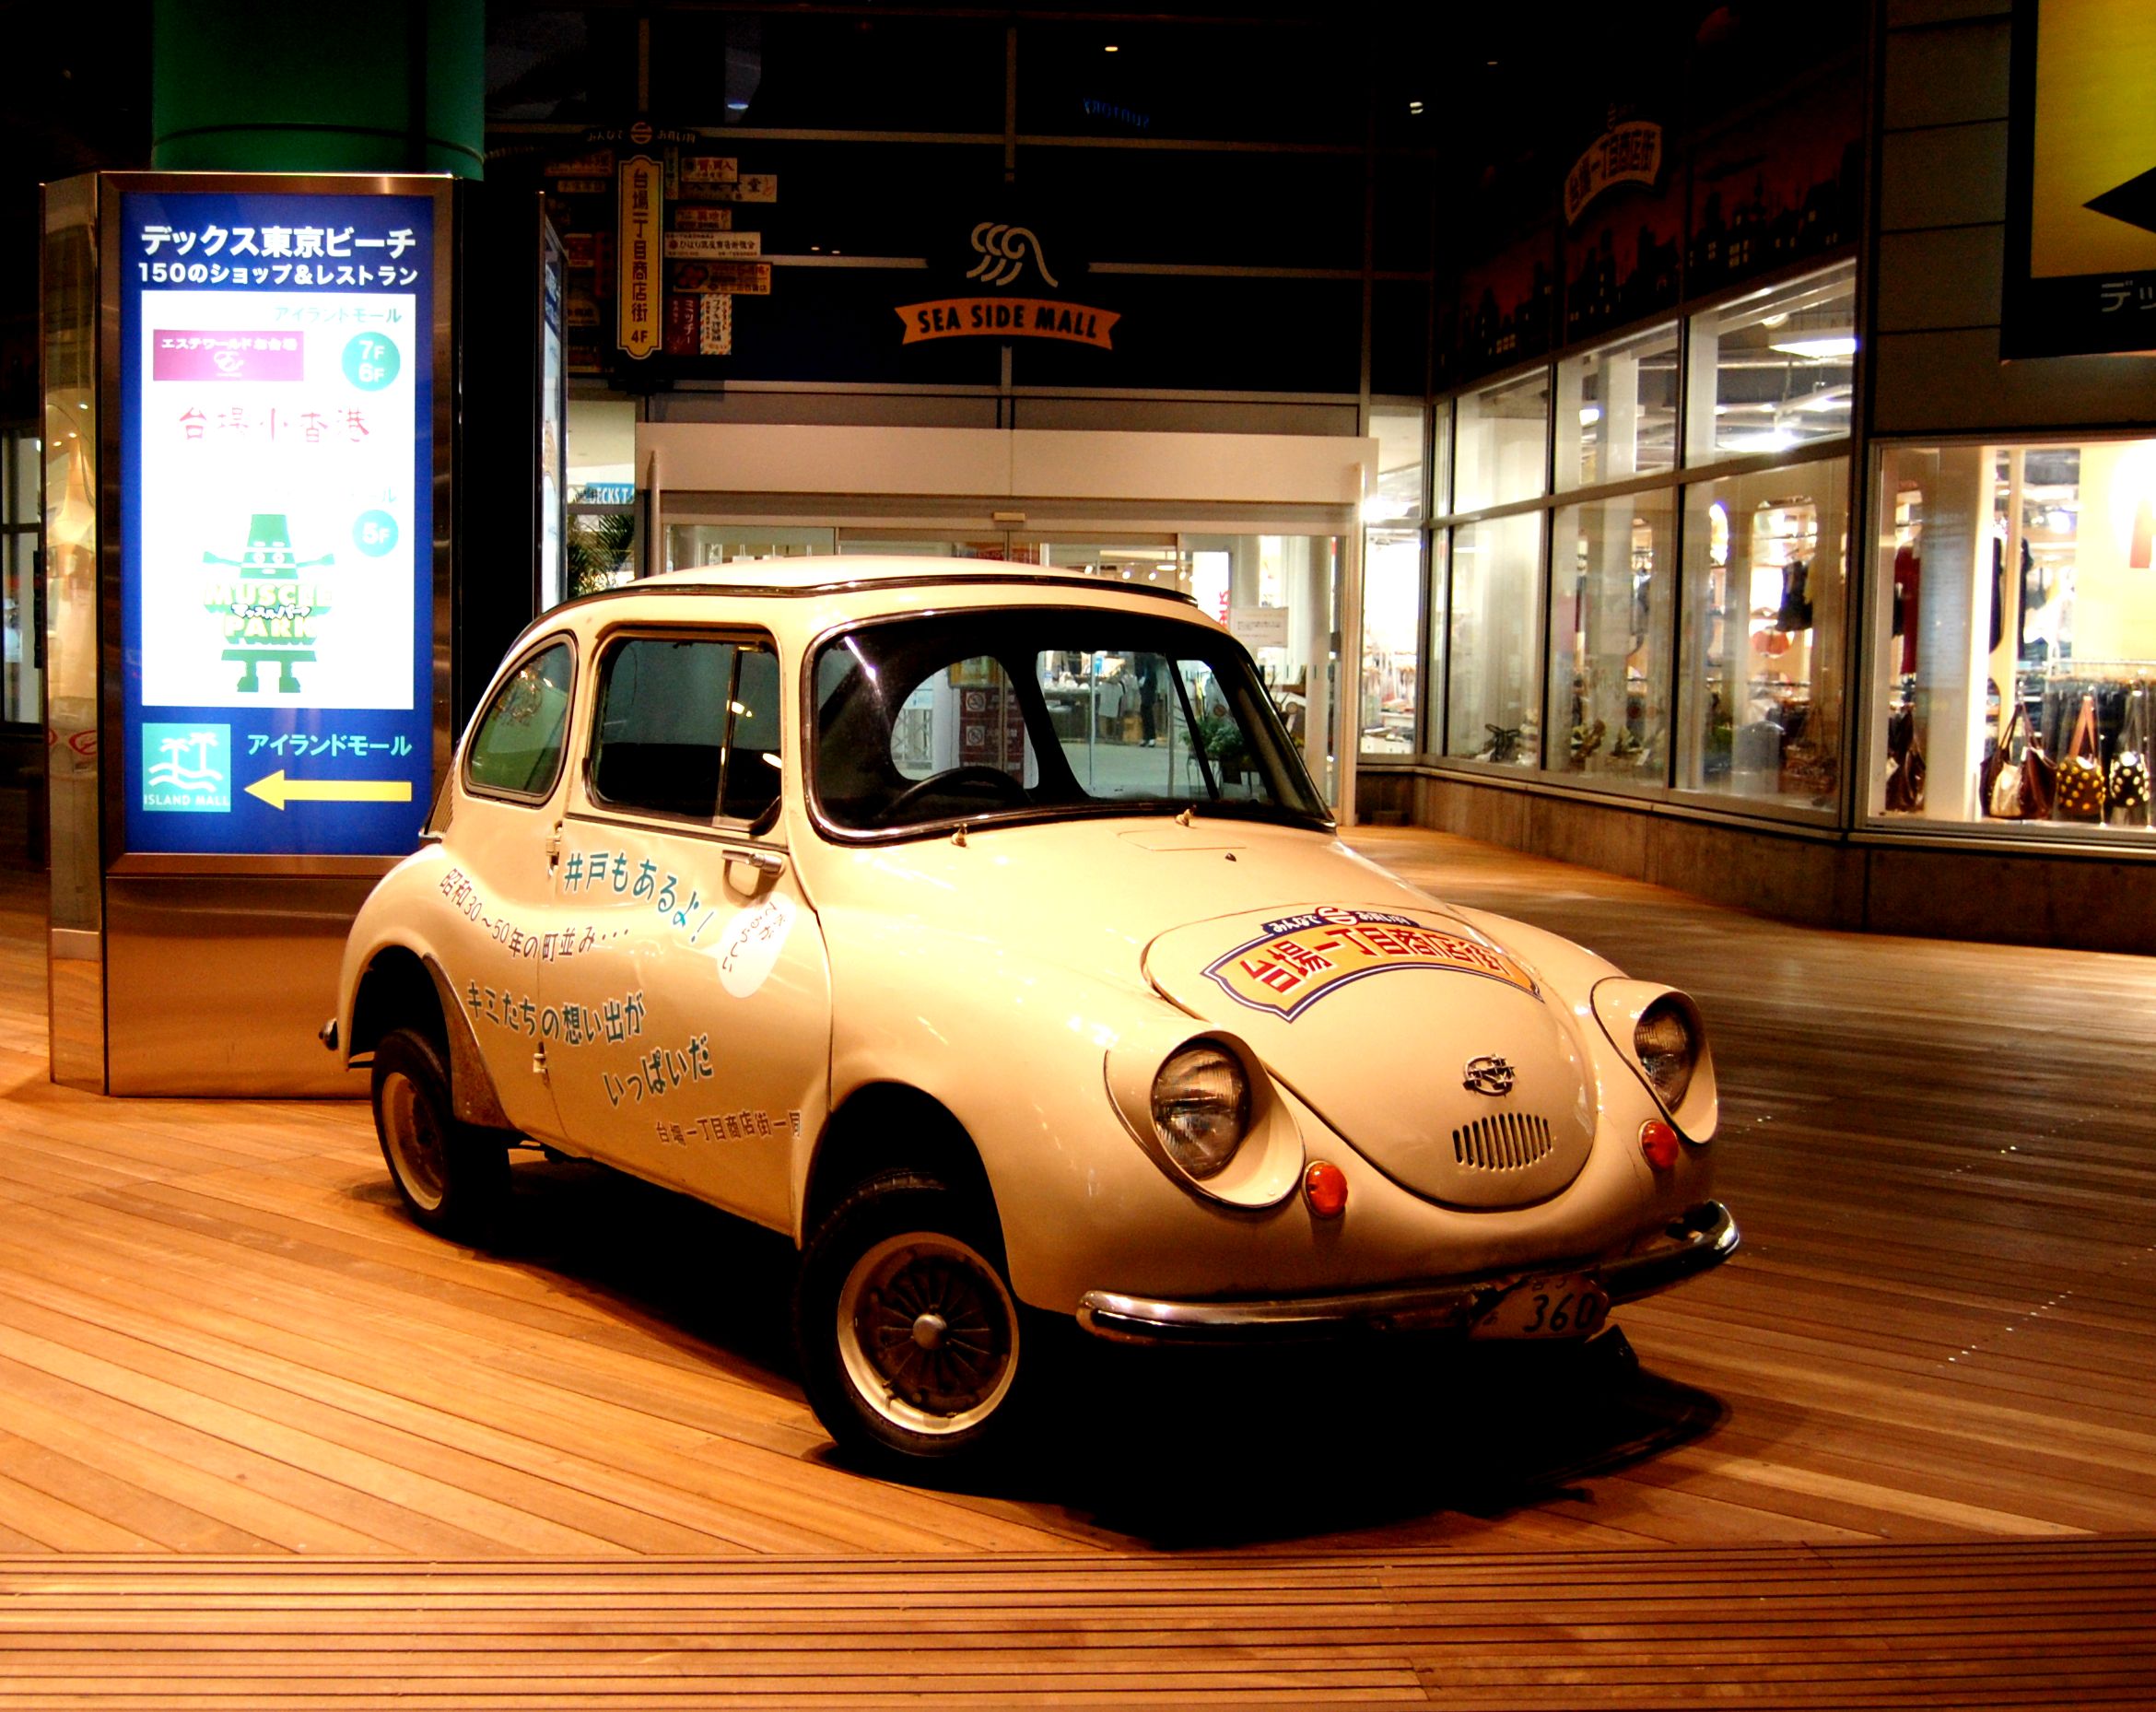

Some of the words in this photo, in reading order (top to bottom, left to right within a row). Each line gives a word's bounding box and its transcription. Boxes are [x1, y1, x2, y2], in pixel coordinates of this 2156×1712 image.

[140, 225, 416, 259] デックス東京ビーチ
[631, 168, 649, 322] 台場一丁目商店街
[137, 263, 418, 286] 150のショップ&レストラン
[630, 329, 649, 344] 4F
[917, 306, 961, 334] SEA
[970, 304, 1025, 329] SIDE
[1035, 305, 1096, 339] MALL
[357, 341, 385, 360] 7F
[357, 365, 385, 384] 6F
[361, 523, 391, 544] 5F
[202, 582, 334, 612] MUSCLE
[224, 616, 318, 642] PARK
[247, 733, 413, 757] アイランドモール
[143, 794, 192, 807] ISLAND
[195, 795, 230, 807] MALL
[1239, 927, 1511, 994] 台場一丁目商店街
[467, 979, 647, 1046] キミたちの想い出が
[603, 1033, 713, 1108] いっぱいだ
[656, 1110, 802, 1146] 台場一丁目商店街一同
[1522, 1292, 1599, 1332] 360
